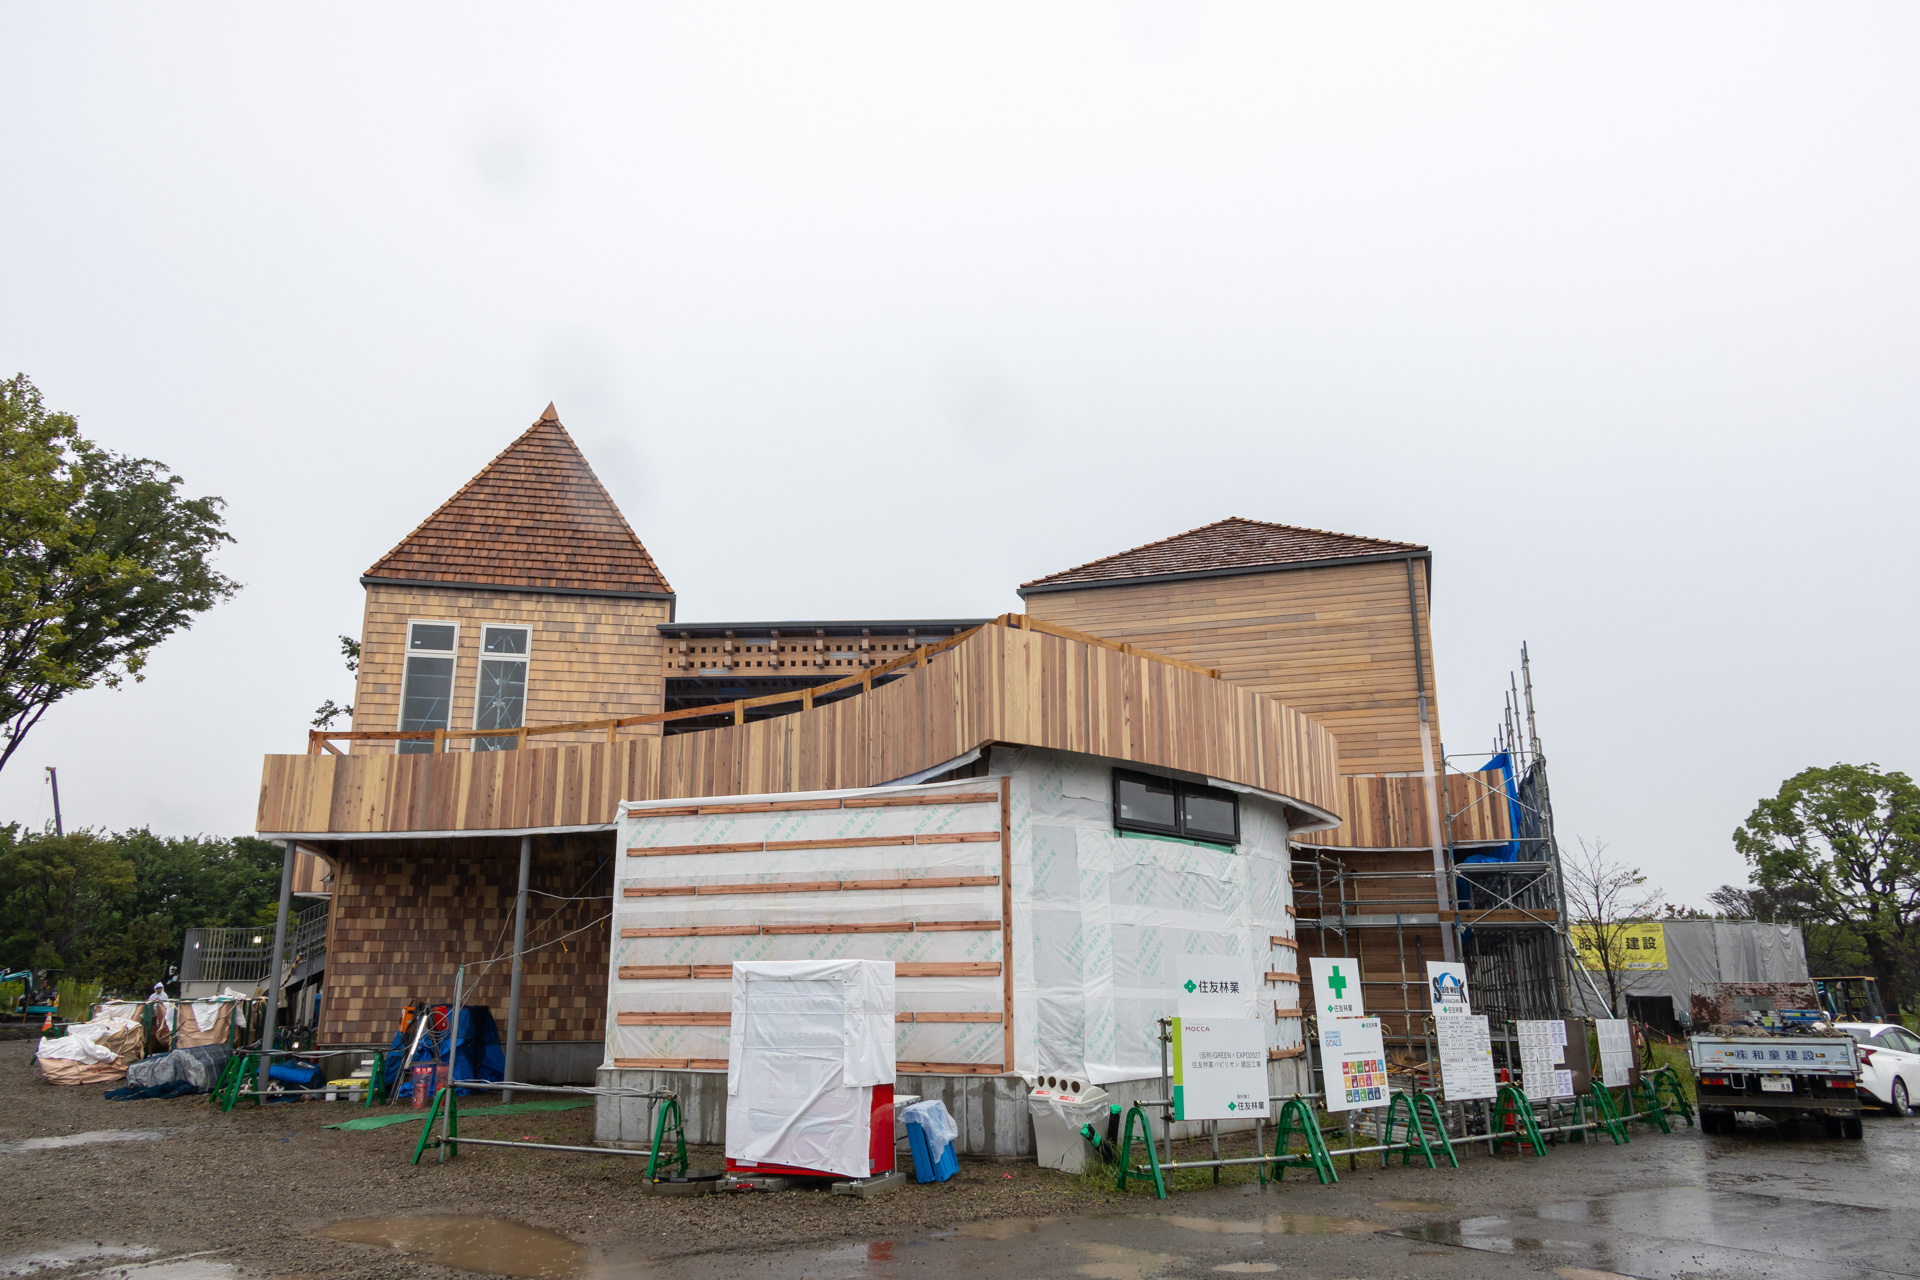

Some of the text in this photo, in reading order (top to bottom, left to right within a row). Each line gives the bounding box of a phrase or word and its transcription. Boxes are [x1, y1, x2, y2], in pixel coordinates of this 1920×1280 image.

[1625, 937, 1656, 950] 建設
[1198, 980, 1240, 994] 住友林業
[1334, 1004, 1352, 1012] 住友林業
[1238, 1101, 1265, 1110] 住友林業
